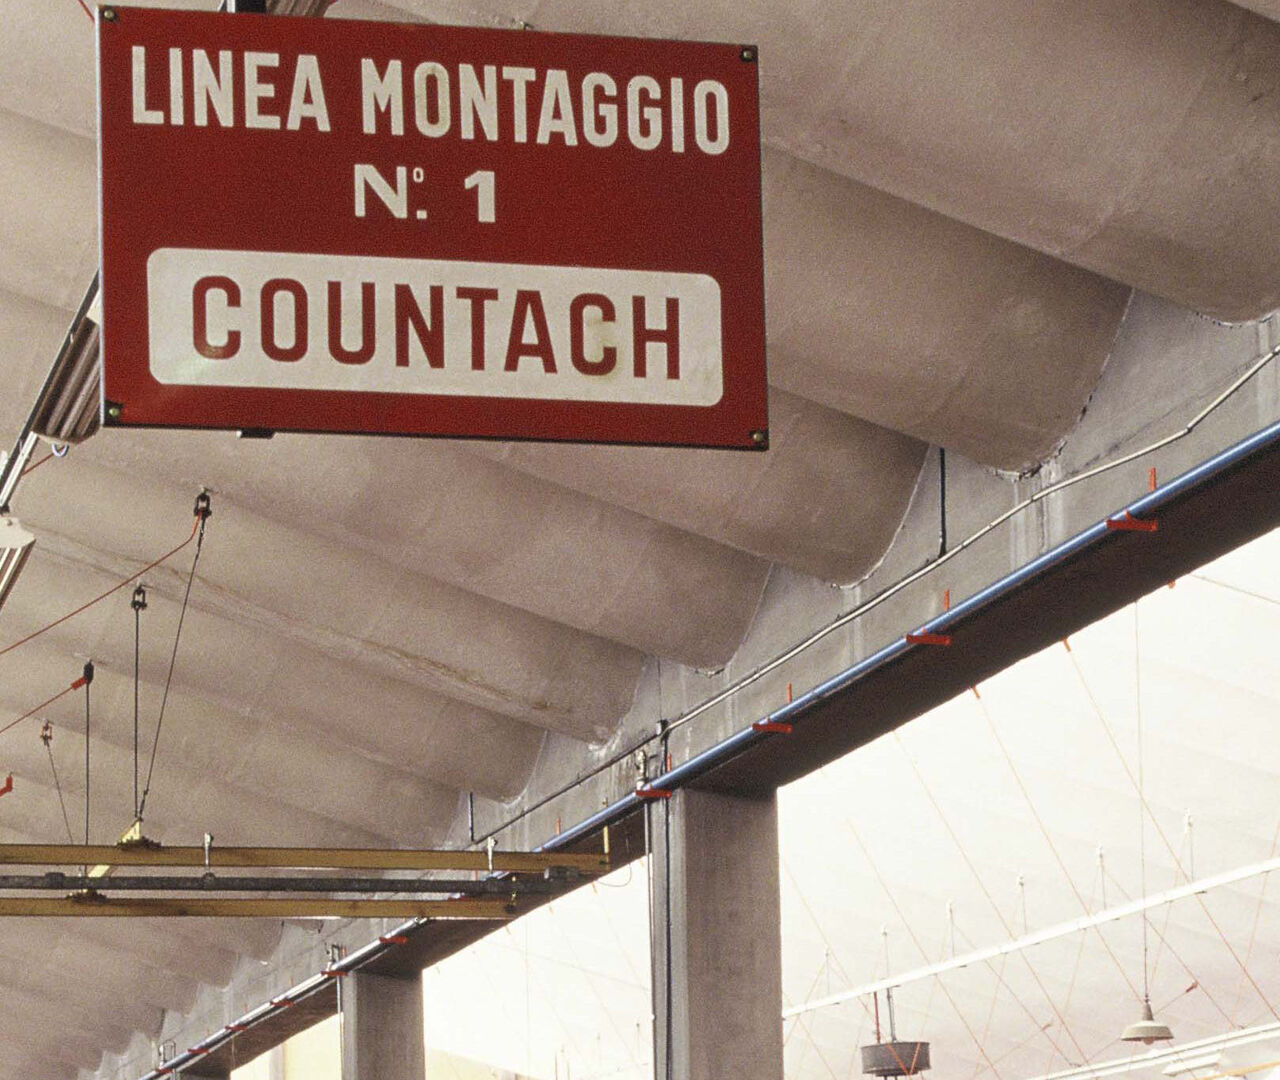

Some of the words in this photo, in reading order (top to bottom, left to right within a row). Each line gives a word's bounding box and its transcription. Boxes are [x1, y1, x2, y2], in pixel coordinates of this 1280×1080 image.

[131, 45, 331, 132] LINEA
[361, 57, 731, 155] MONTAGGIO
[464, 170, 496, 223] 1
[191, 274, 682, 381] COUNTACH
